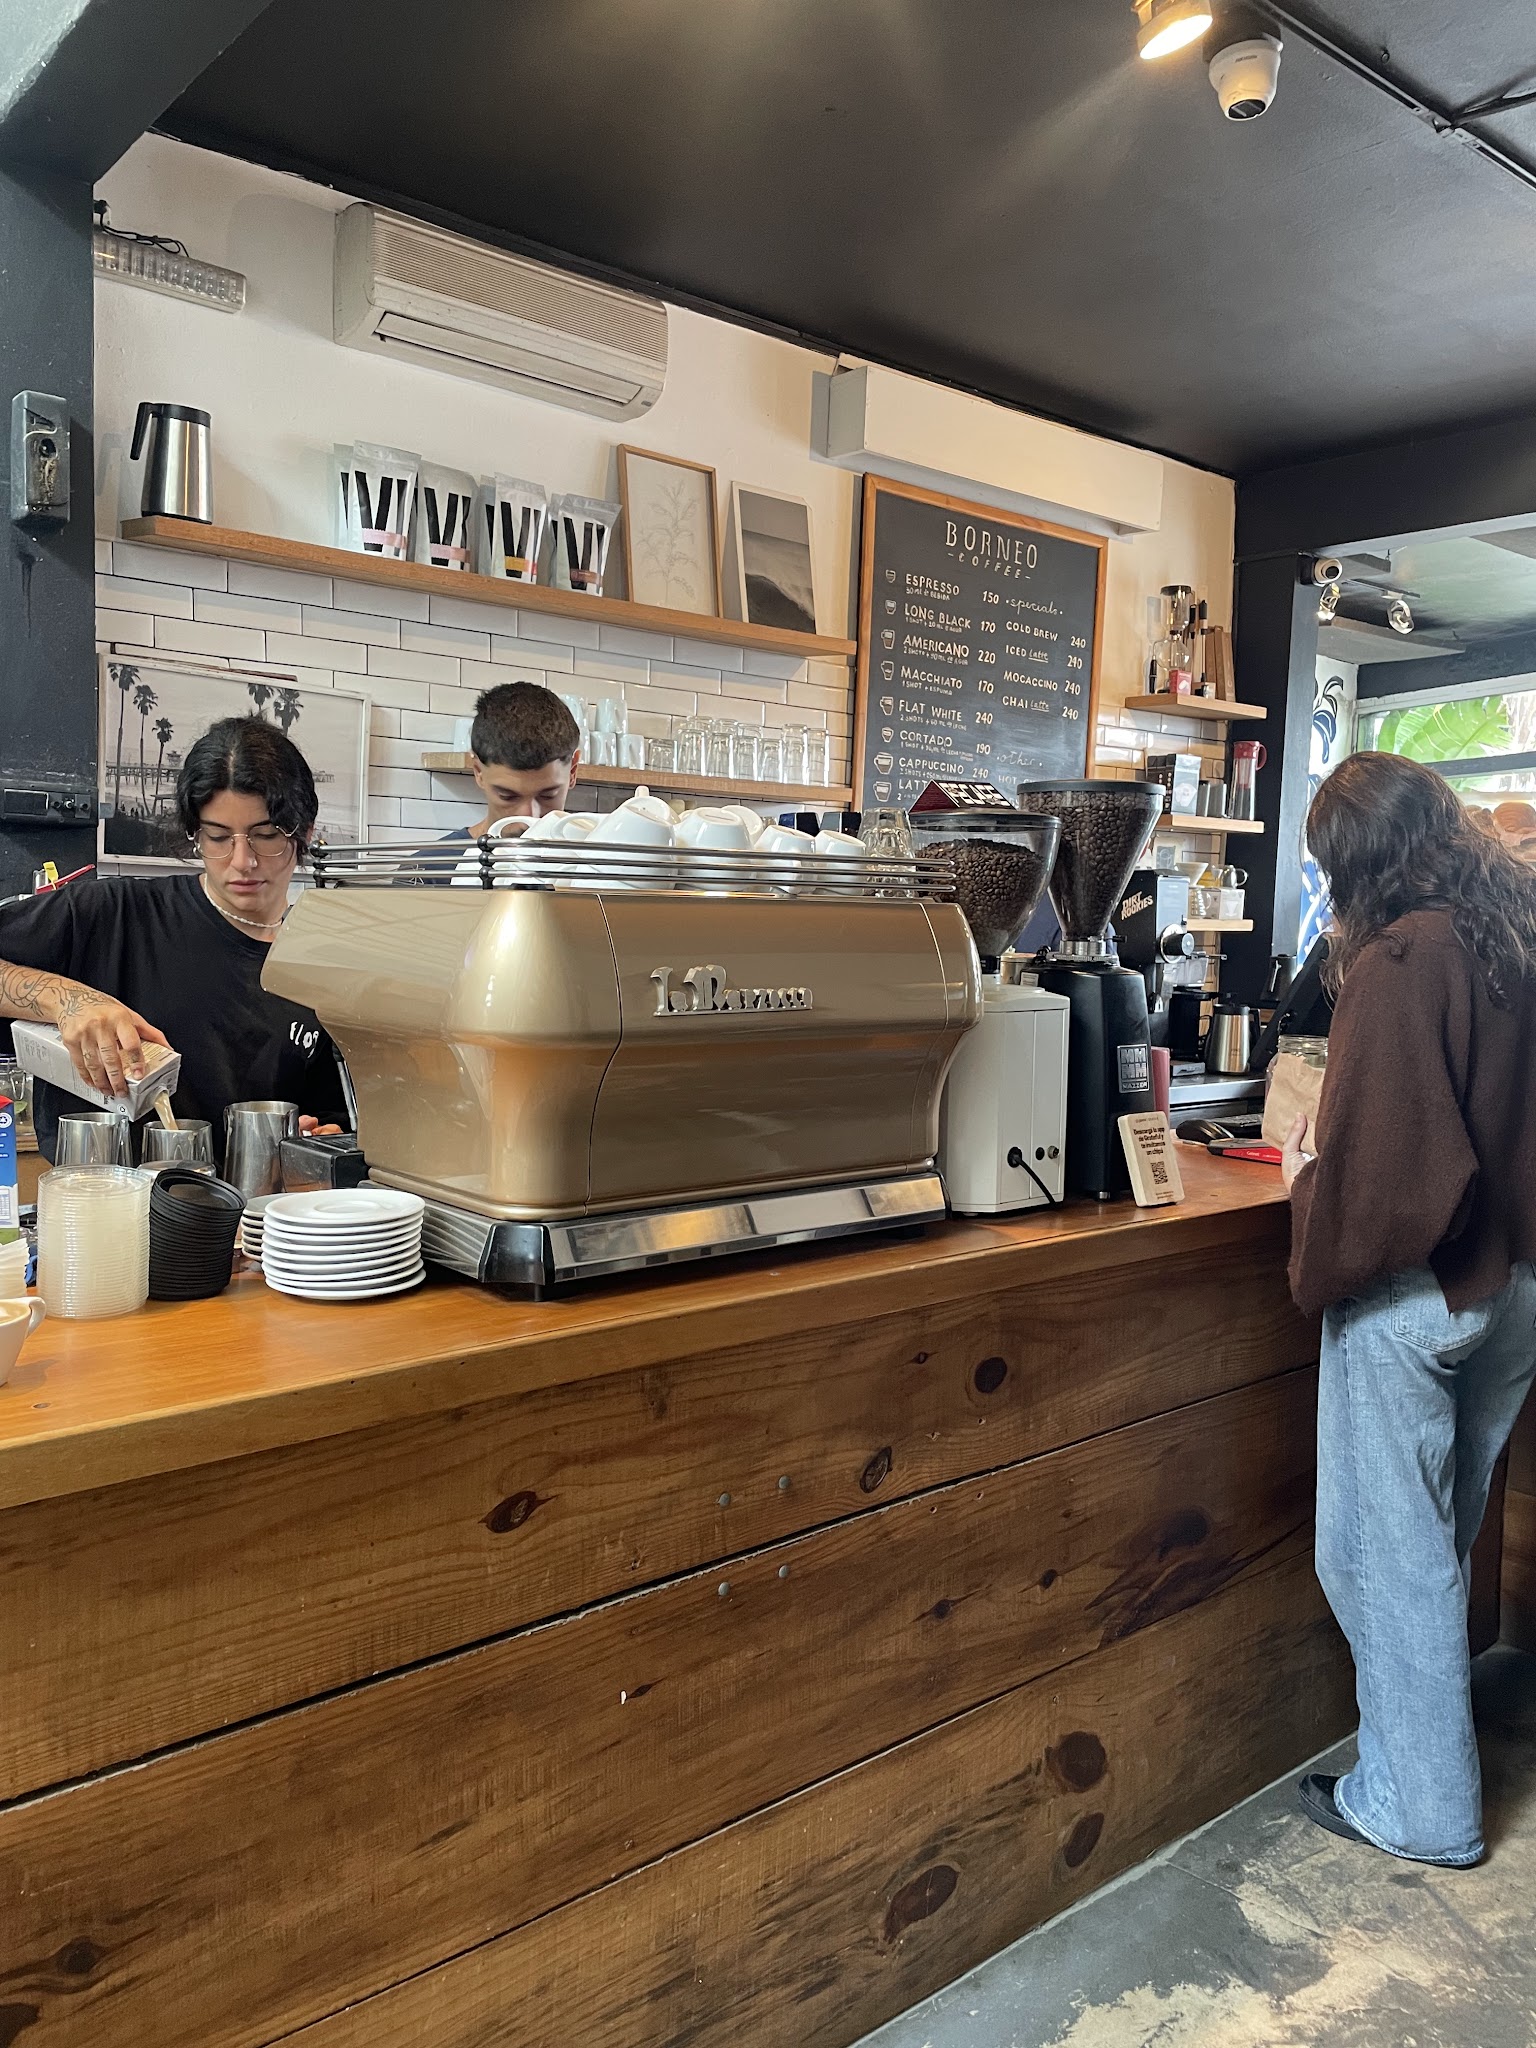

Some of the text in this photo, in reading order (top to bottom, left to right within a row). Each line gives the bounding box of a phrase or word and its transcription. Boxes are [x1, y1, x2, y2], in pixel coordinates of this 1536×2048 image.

[945, 520, 1037, 569] BORNEO
[958, 552, 1022, 579] COFFEE
[905, 573, 999, 604] ESPRESSO 150
[904, 603, 996, 634] LONG BLACK 170
[1010, 598, 1058, 615] specials
[1006, 621, 1086, 648] COLD BREW 240
[903, 634, 996, 664] AMERICANO 220
[1006, 644, 1026, 657] ICED
[1067, 655, 1083, 670] 240
[900, 666, 994, 694] MACCHIATO 170
[1004, 670, 1081, 696] MOCACCINO 240
[899, 700, 993, 724] FLAT WHITE 240
[1002, 696, 1028, 708] CHAI
[1062, 706, 1079, 720] 240
[900, 730, 991, 755] CORTADO 190
[898, 757, 964, 774] CAPPUCCINO
[972, 768, 989, 779] 240
[897, 792, 902, 801] 2
[898, 779, 928, 790] LATT
[1121, 895, 1154, 920] ROOKIES
[1122, 890, 1142, 910] DIRT
